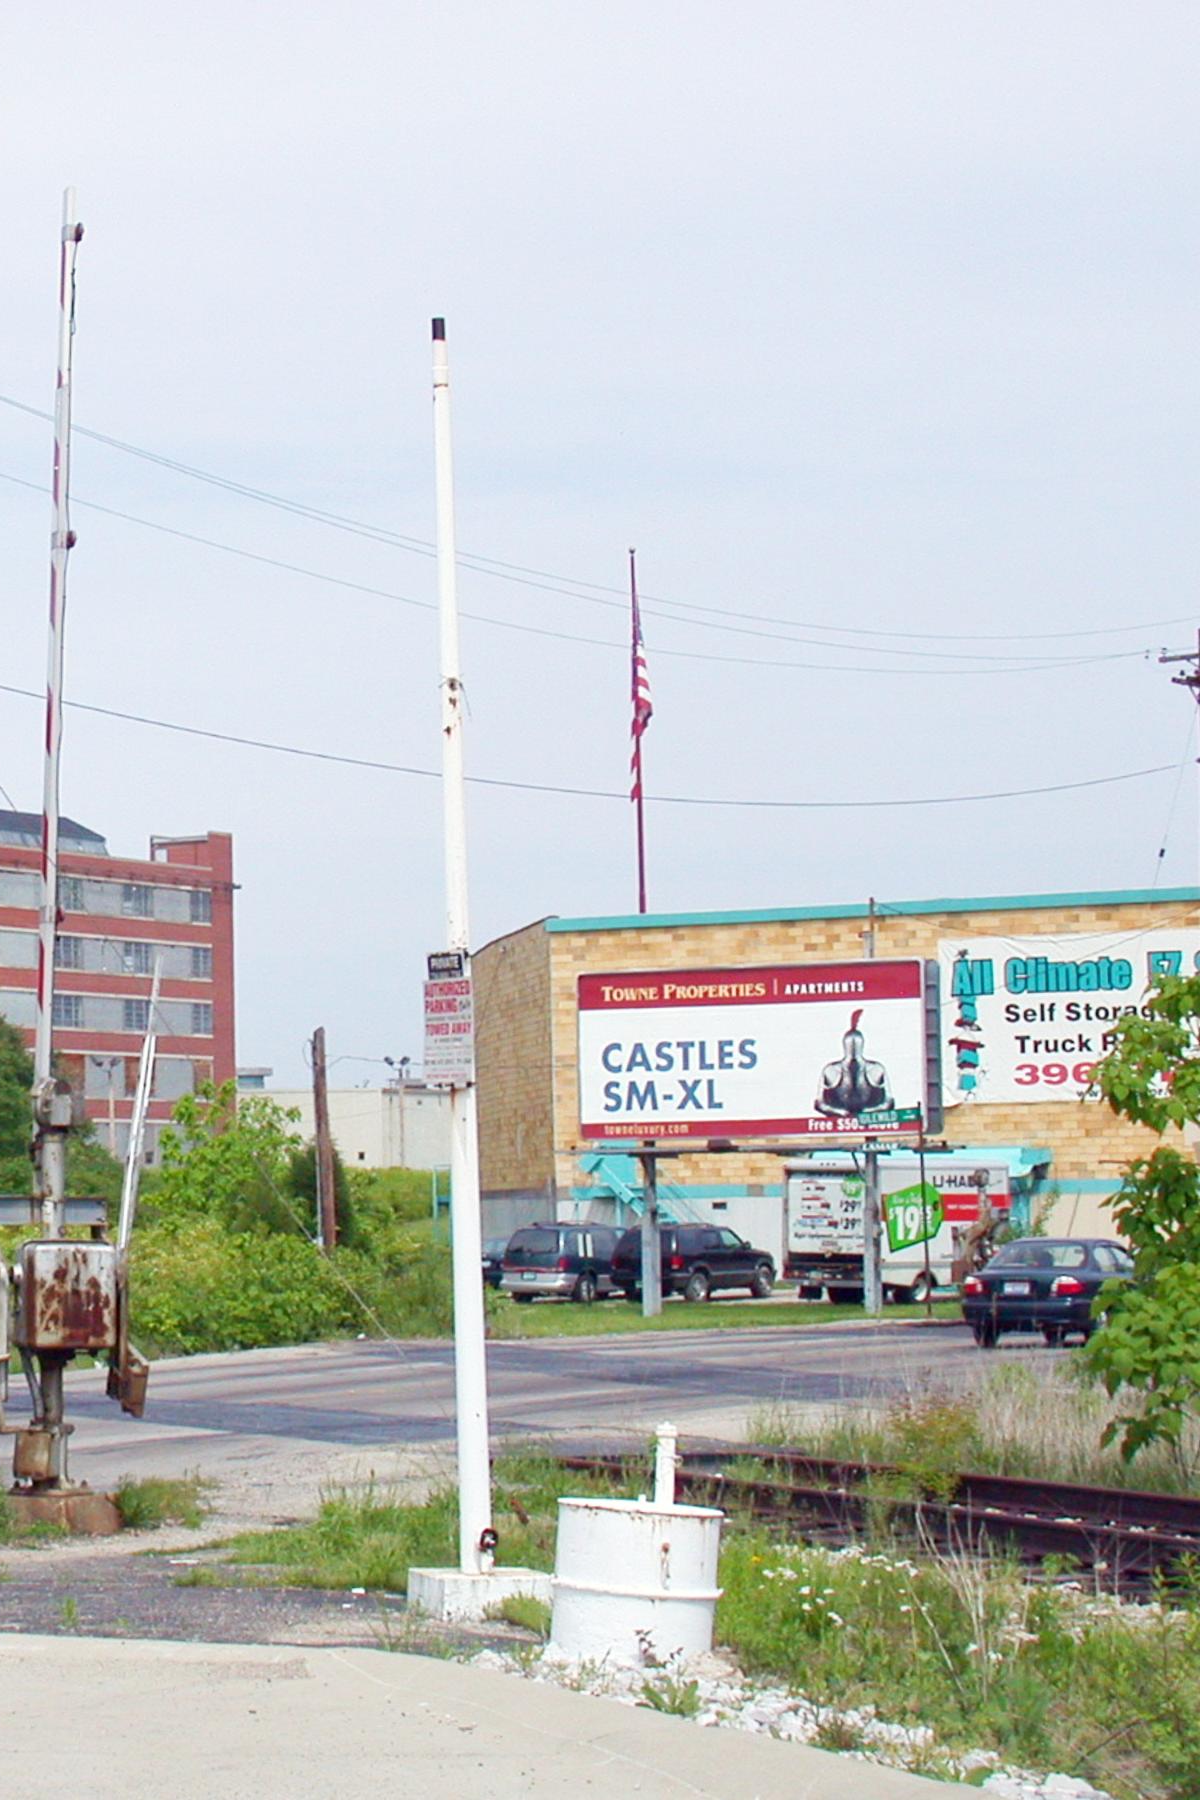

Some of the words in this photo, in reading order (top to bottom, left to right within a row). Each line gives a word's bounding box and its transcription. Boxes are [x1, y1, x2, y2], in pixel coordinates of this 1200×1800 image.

[952, 958, 994, 997] All
[1004, 956, 1132, 995] Climate
[602, 986, 659, 1002] TOWNE
[663, 981, 766, 1000] PROPERTIES
[784, 981, 864, 996] APARTMENTS
[425, 998, 458, 1014] PARKING
[1005, 1003, 1056, 1023] Self
[1065, 1001, 1167, 1023] Storag
[425, 1022, 449, 1036] TOWED
[452, 1022, 471, 1035] AWAY
[1015, 1034, 1091, 1054] Truck
[602, 1038, 758, 1074] CASTLES
[603, 1079, 723, 1113] SM-XL
[603, 1123, 689, 1136] towneluxury.com
[808, 1118, 833, 1132] Free
[862, 1142, 898, 1151] LAMAR
